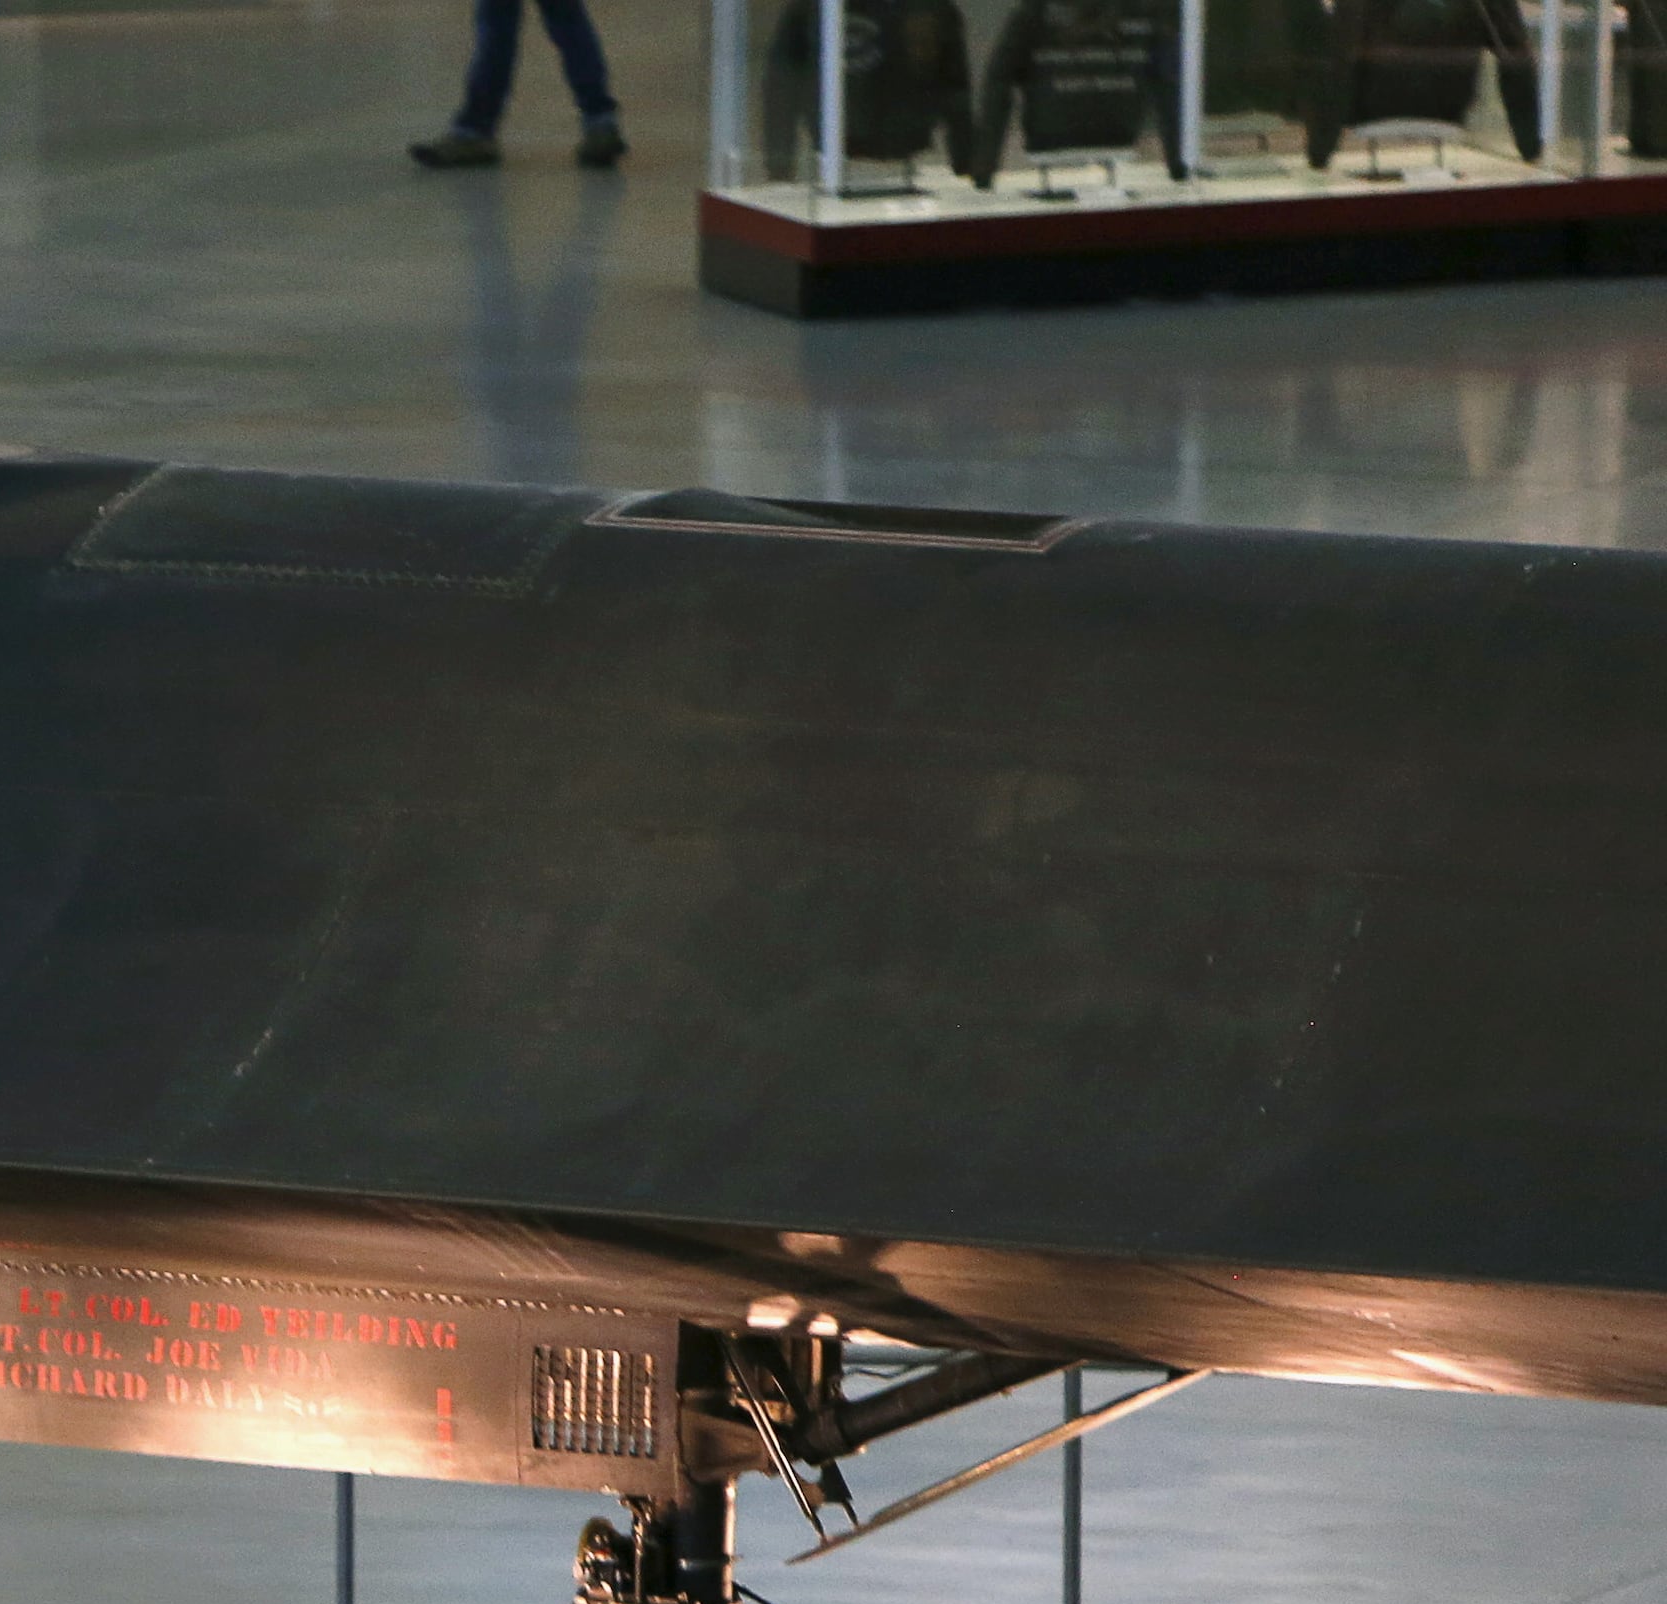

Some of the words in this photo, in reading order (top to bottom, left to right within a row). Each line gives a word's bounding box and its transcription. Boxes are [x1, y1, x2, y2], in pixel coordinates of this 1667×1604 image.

[189, 1301, 243, 1333] ED
[259, 1305, 457, 1350] YEILDING
[146, 1335, 221, 1371] JOE
[242, 1343, 336, 1381] VIDA
[165, 1373, 264, 1413] DALY
